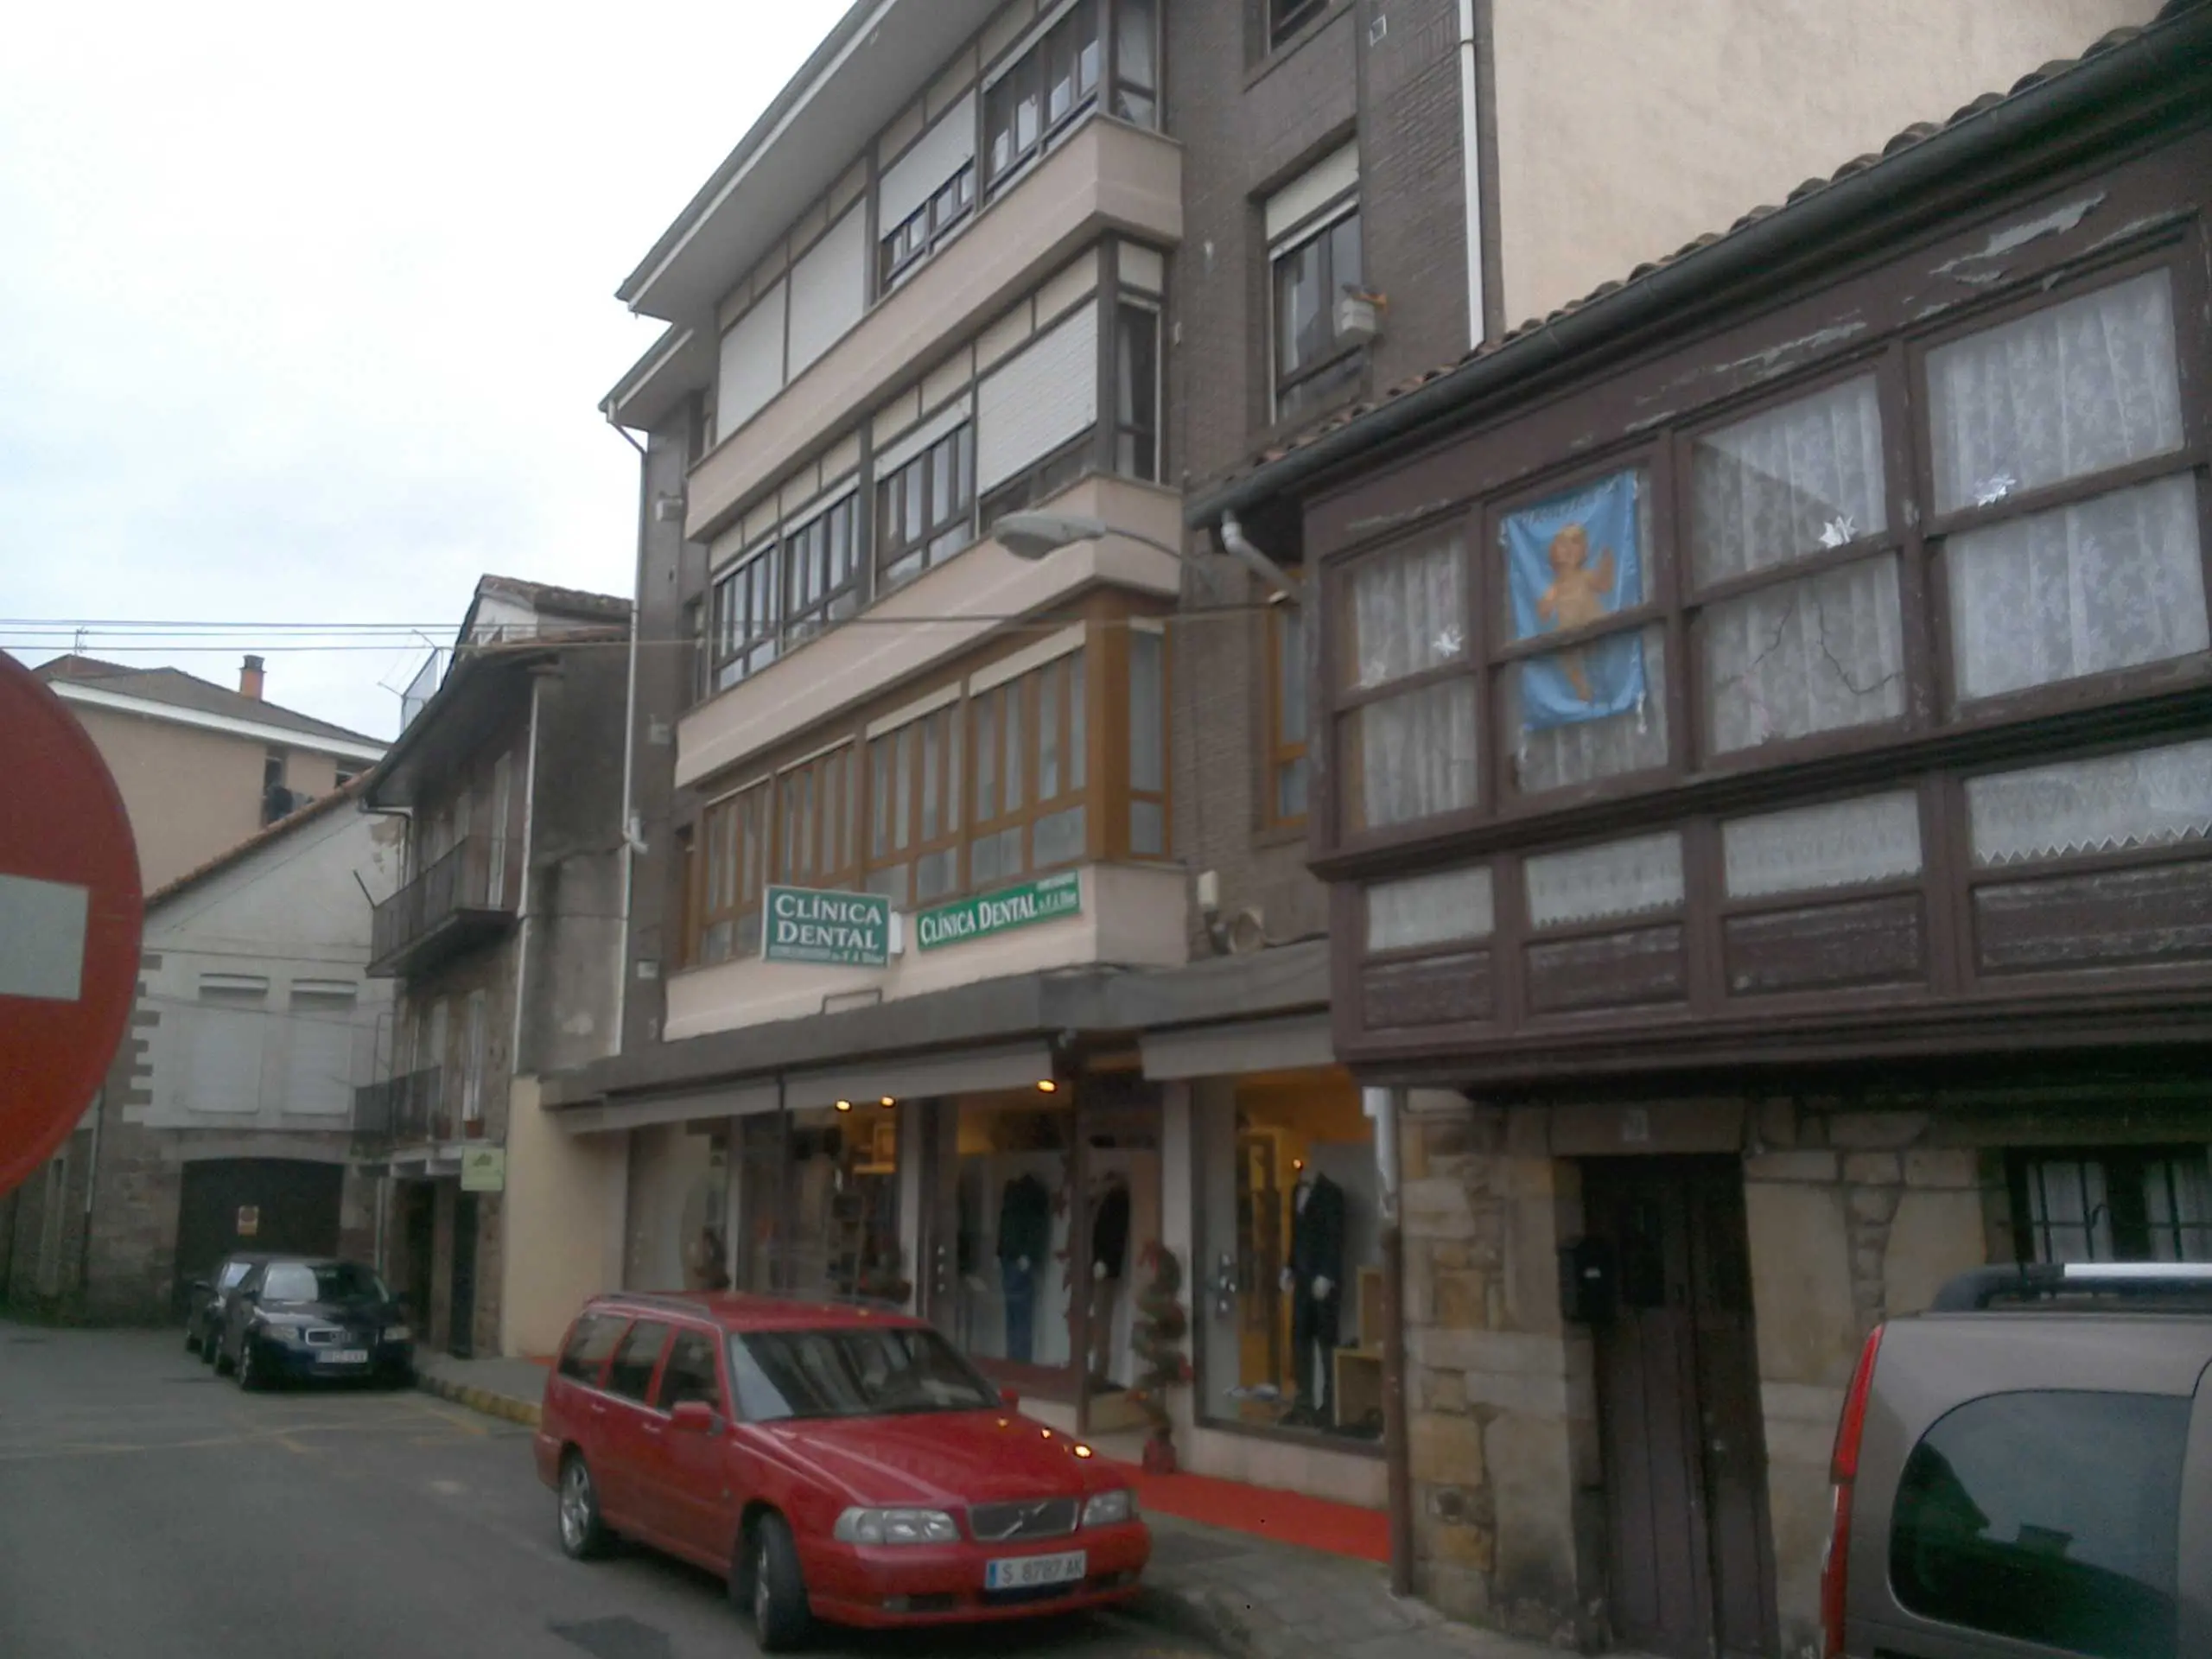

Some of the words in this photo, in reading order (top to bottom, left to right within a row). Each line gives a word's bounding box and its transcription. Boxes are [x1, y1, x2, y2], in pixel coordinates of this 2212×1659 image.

[775, 893, 882, 926] CLÍNICA
[977, 893, 1039, 931] DENTAL
[777, 919, 880, 950] DENTAL
